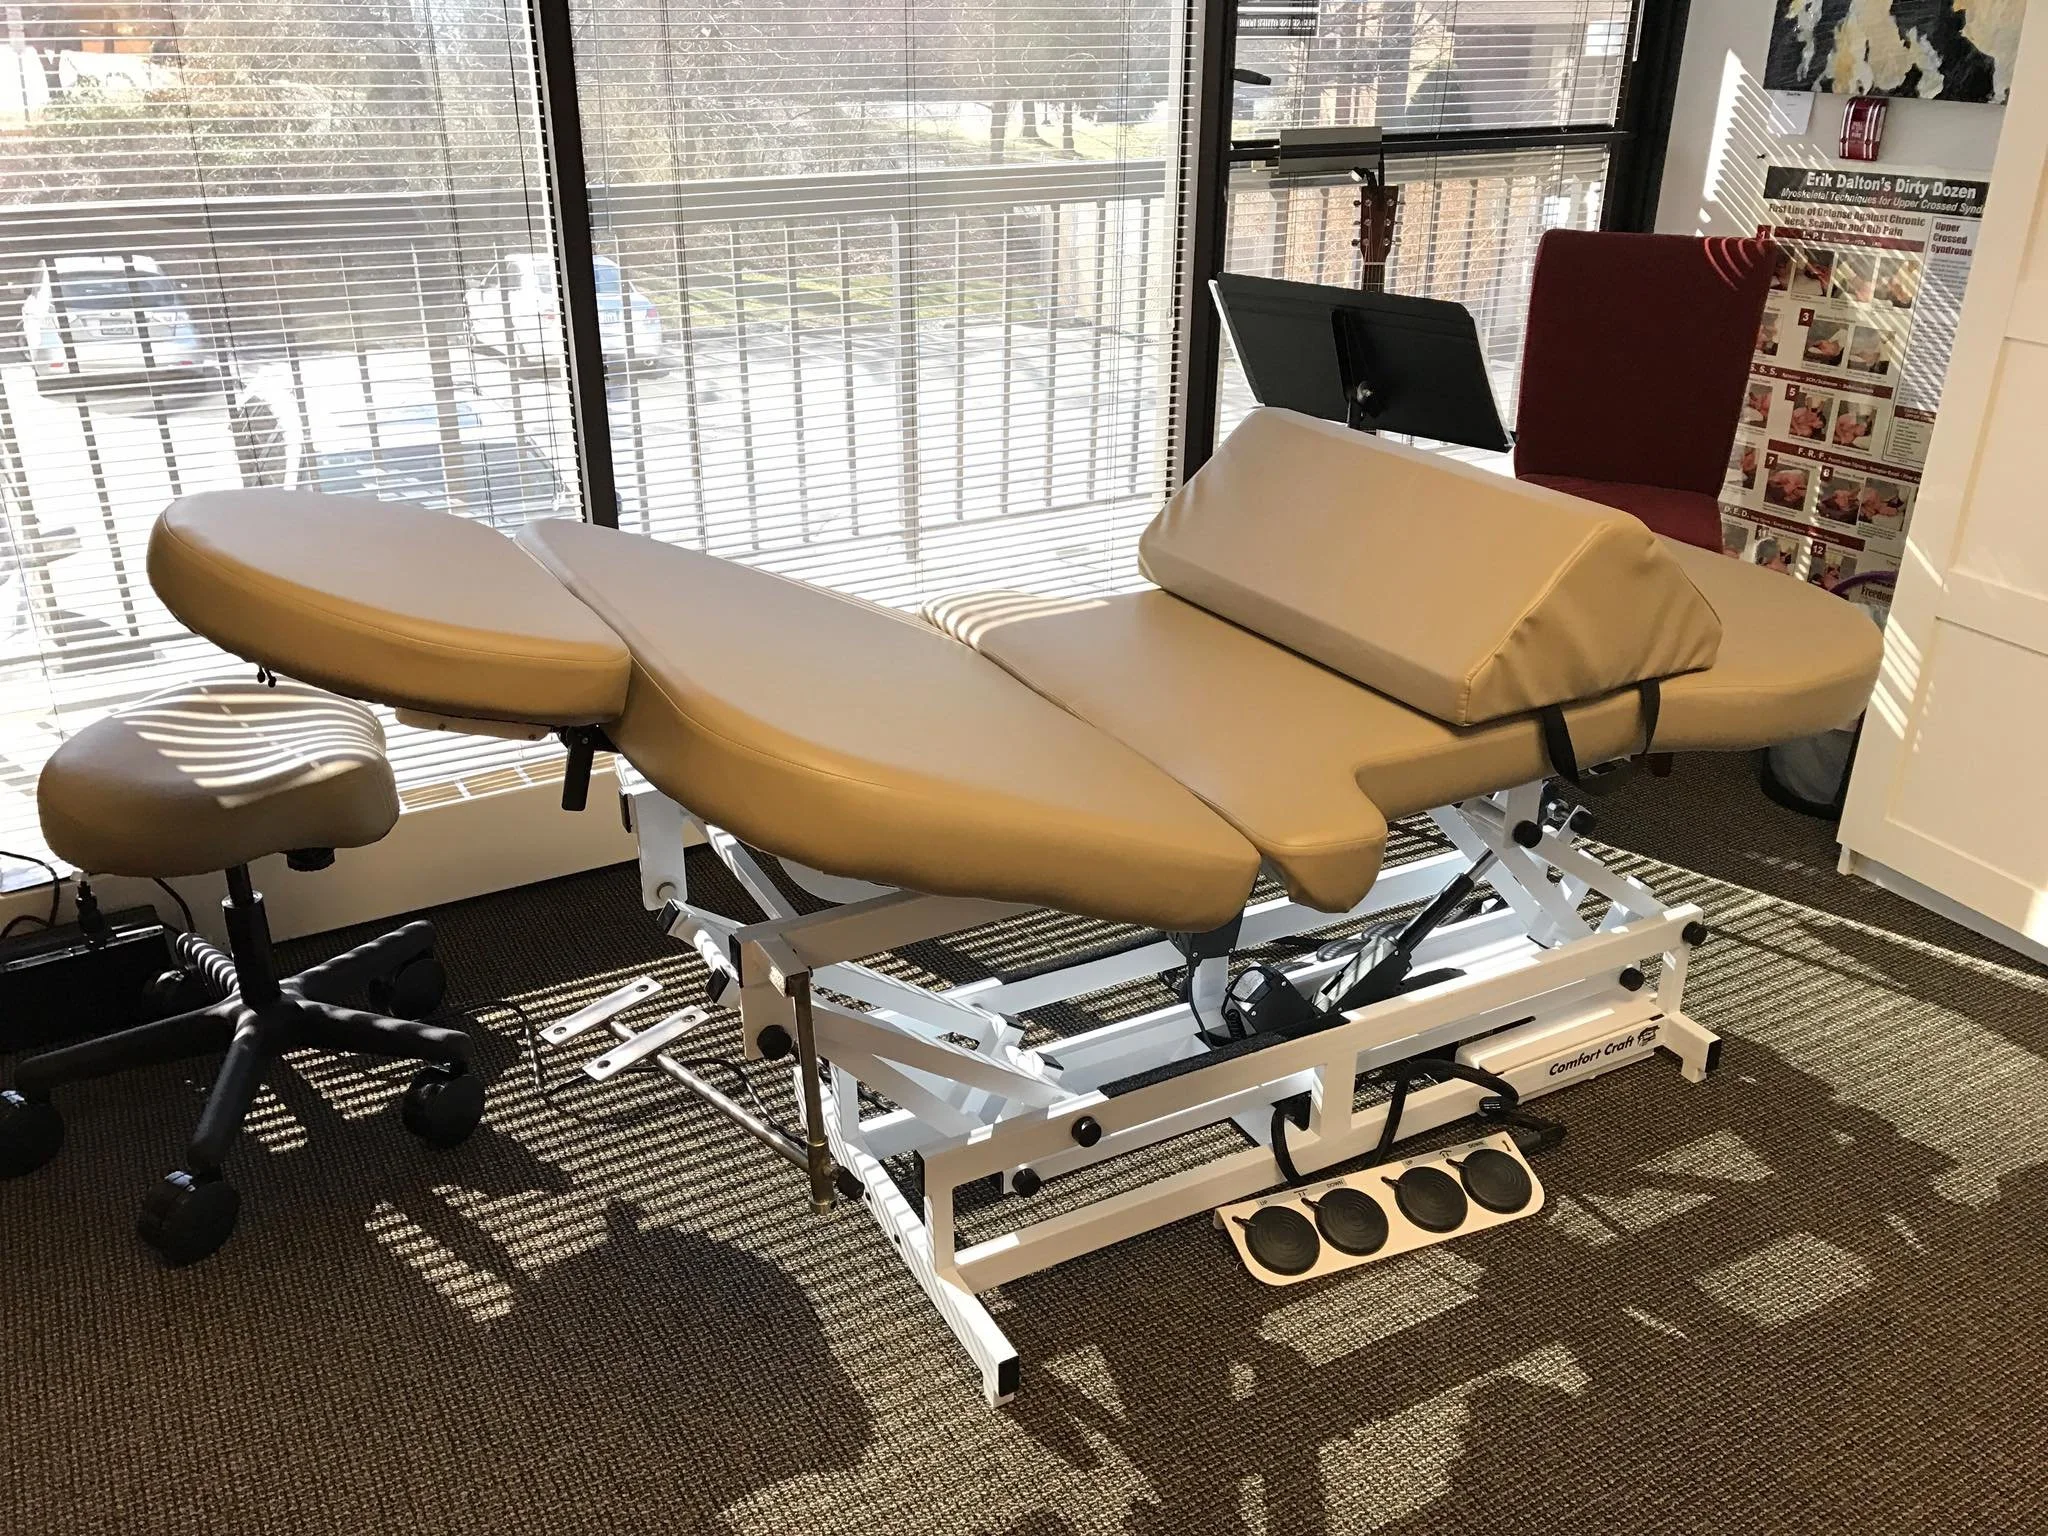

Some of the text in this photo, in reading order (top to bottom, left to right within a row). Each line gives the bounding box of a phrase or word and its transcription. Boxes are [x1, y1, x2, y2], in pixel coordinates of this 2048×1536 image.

[1806, 171, 1977, 199] Erik Dalton's Dirty Dozen
[1780, 187, 1828, 200] Myoskeletal
[1830, 191, 1877, 205] Techniques
[1879, 195, 1891, 206] for
[1893, 197, 1919, 209] Upper
[1921, 199, 1958, 212] Crossed
[1769, 203, 1787, 213] First
[1788, 204, 1806, 215] Line
[1807, 207, 1816, 216] of
[1854, 211, 1888, 223] Against
[1889, 214, 1926, 227] Chronic
[1848, 222, 1865, 233] and
[1866, 224, 1881, 235] Rib
[1882, 225, 1903, 237] Pain
[1935, 221, 1960, 232] Upper
[1933, 232, 1968, 245] Crossed
[1931, 244, 1973, 257] Syndrome
[1802, 312, 1809, 322] 3
[1789, 387, 1796, 396] 5
[1768, 456, 1775, 465] 7
[1813, 545, 1824, 555] 12
[1549, 1035, 1635, 1076] Comfort Craft
